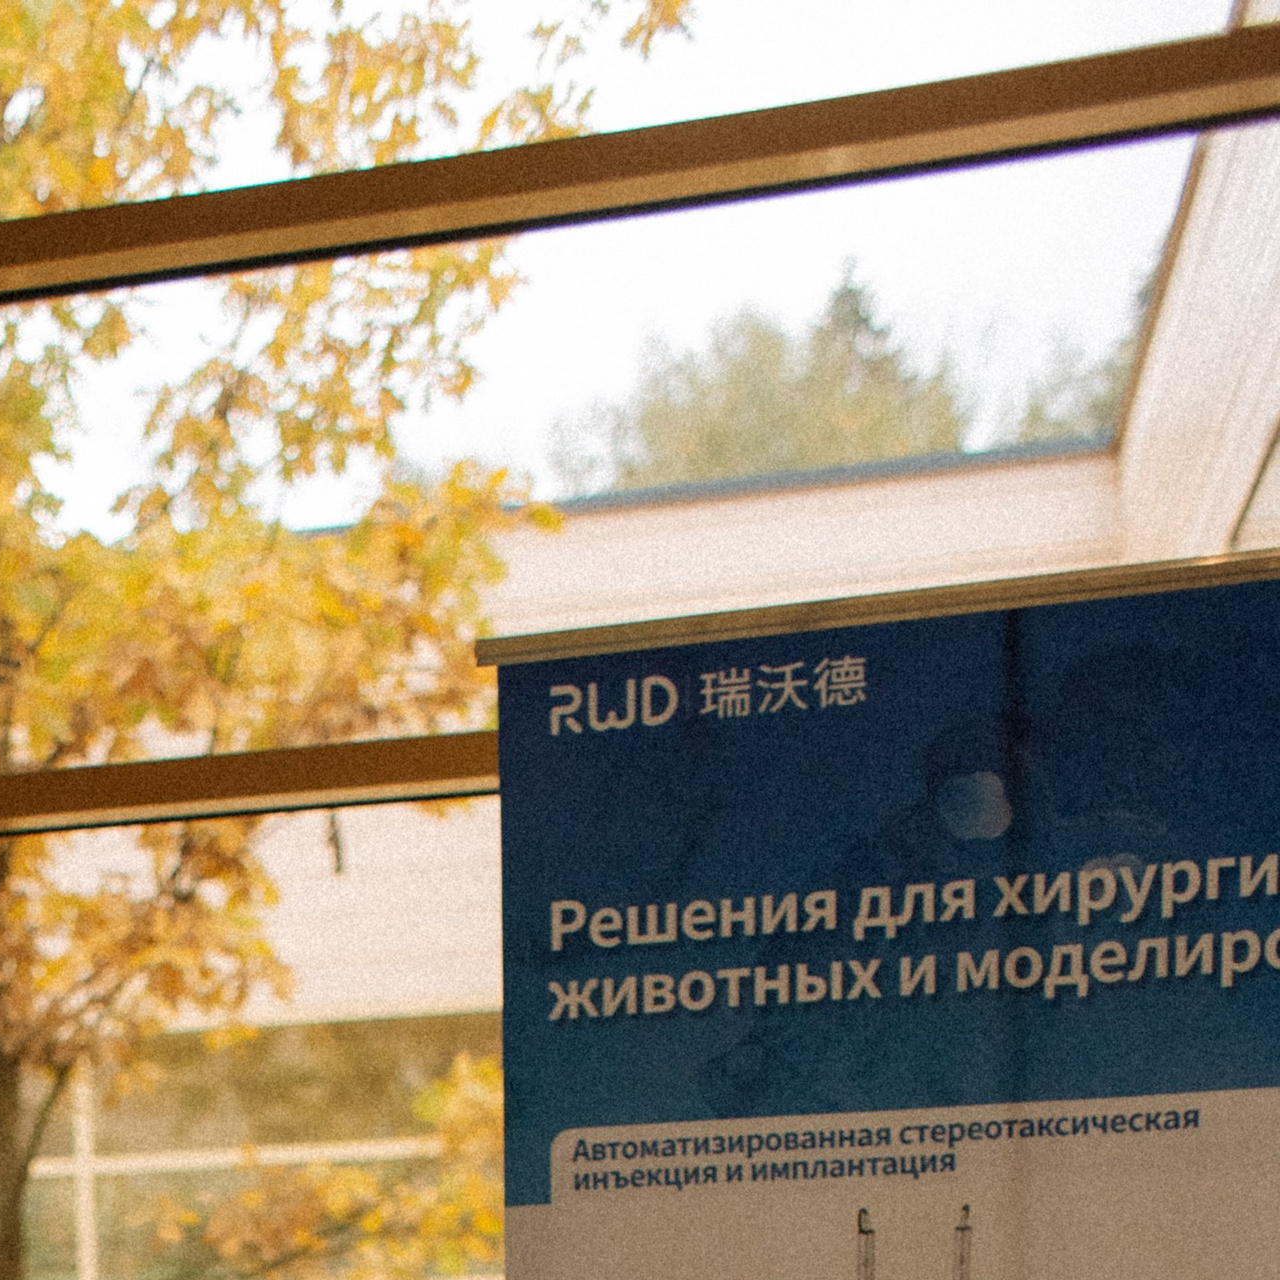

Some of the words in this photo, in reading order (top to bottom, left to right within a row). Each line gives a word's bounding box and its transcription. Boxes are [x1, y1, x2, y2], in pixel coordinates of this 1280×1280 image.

[549, 674, 678, 735] RWD
[700, 655, 868, 721] 瑞沃德
[550, 888, 838, 952] Решения
[853, 877, 976, 942] для
[547, 957, 882, 1022] животных
[899, 953, 936, 998] и
[572, 1121, 892, 1165] Автоматизированная
[898, 1105, 1201, 1148] стереотаксическая
[572, 1157, 717, 1194] инъекция
[725, 1159, 743, 1183] и
[750, 1149, 957, 1185] имплантация
